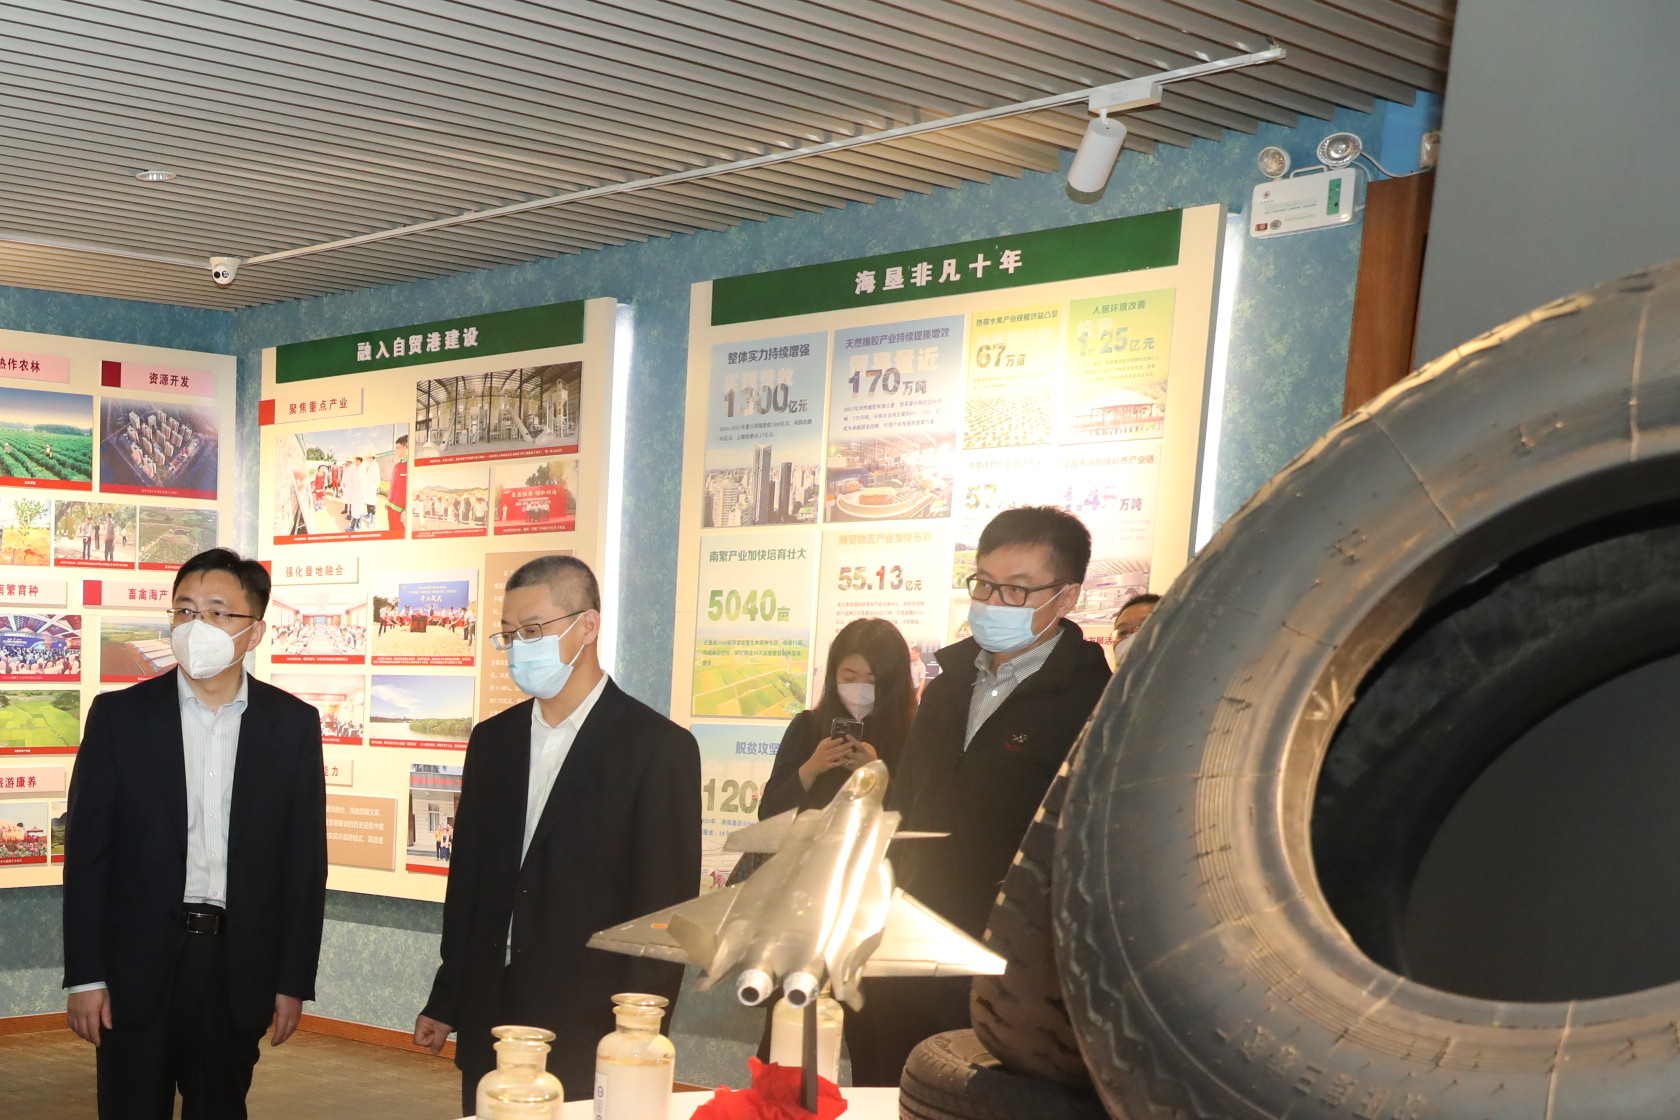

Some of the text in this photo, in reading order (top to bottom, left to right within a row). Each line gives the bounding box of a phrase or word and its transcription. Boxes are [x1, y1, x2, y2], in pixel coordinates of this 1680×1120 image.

[854, 249, 1024, 295] 海垦非凡十年
[357, 326, 479, 363] 融入自贸港建设
[845, 328, 950, 349] 天然橡胶产业持续提质增效
[728, 344, 810, 365] 整体实力持续增强
[148, 372, 190, 388] 资源开发
[848, 367, 928, 397] 170万吨
[289, 397, 348, 416] 聚焦重点产业
[724, 383, 808, 418] 1300亿元
[709, 548, 807, 562] 南繁产业加快培育壮大
[285, 565, 344, 578] 强化垦地融合
[838, 565, 922, 591] 55.13亿元
[128, 588, 168, 601] 畜禽海产
[708, 589, 790, 622] 5040亩
[1084, 636, 1114, 645] 发展活
